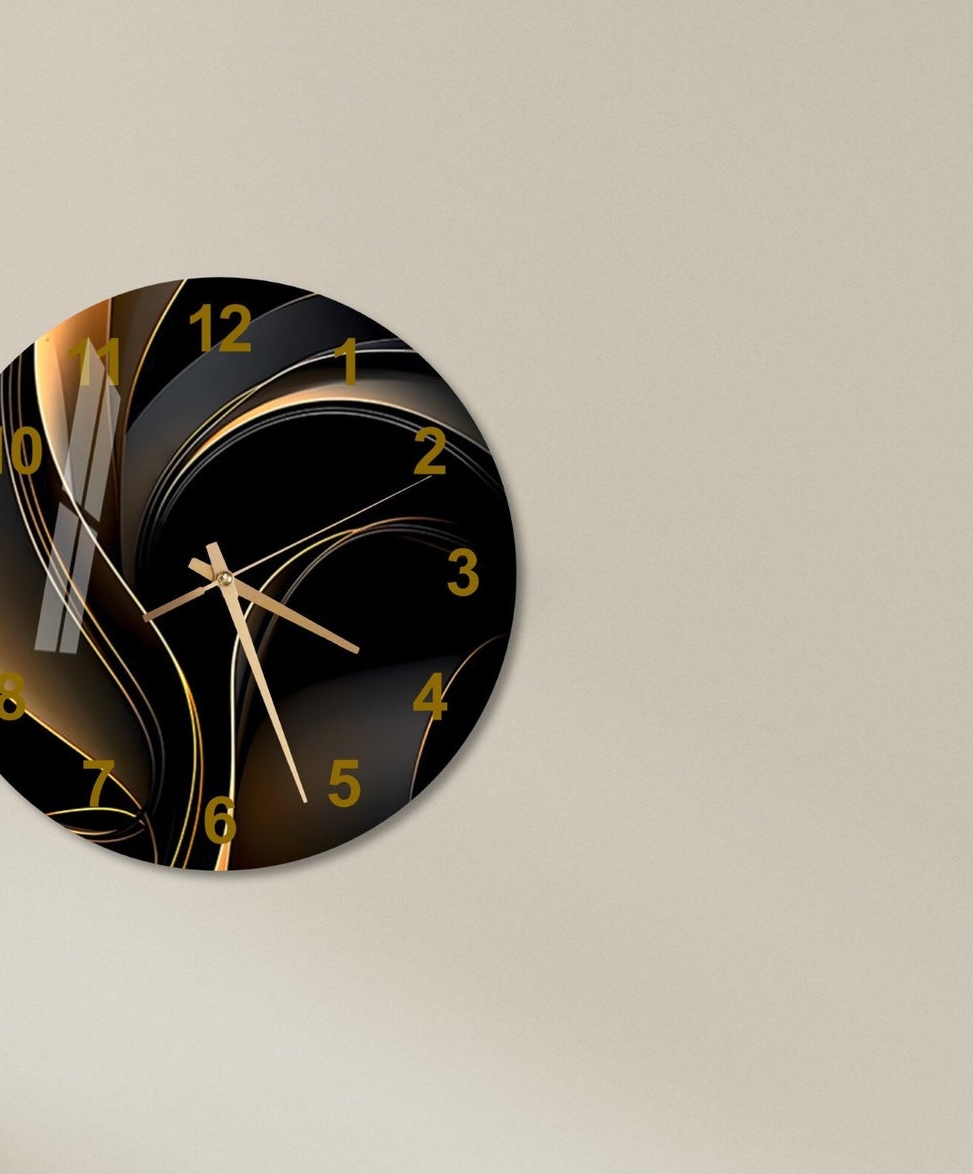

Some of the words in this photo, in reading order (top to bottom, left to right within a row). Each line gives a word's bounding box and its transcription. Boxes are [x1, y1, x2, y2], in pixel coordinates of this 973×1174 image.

[189, 304, 251, 352] 12
[69, 338, 120, 386] 11
[333, 338, 357, 386] 1
[414, 426, 446, 475] 2
[447, 548, 480, 597] 3
[413, 673, 448, 721] 4
[83, 760, 116, 807] 7
[328, 760, 361, 808] 5
[204, 796, 237, 845] 6
